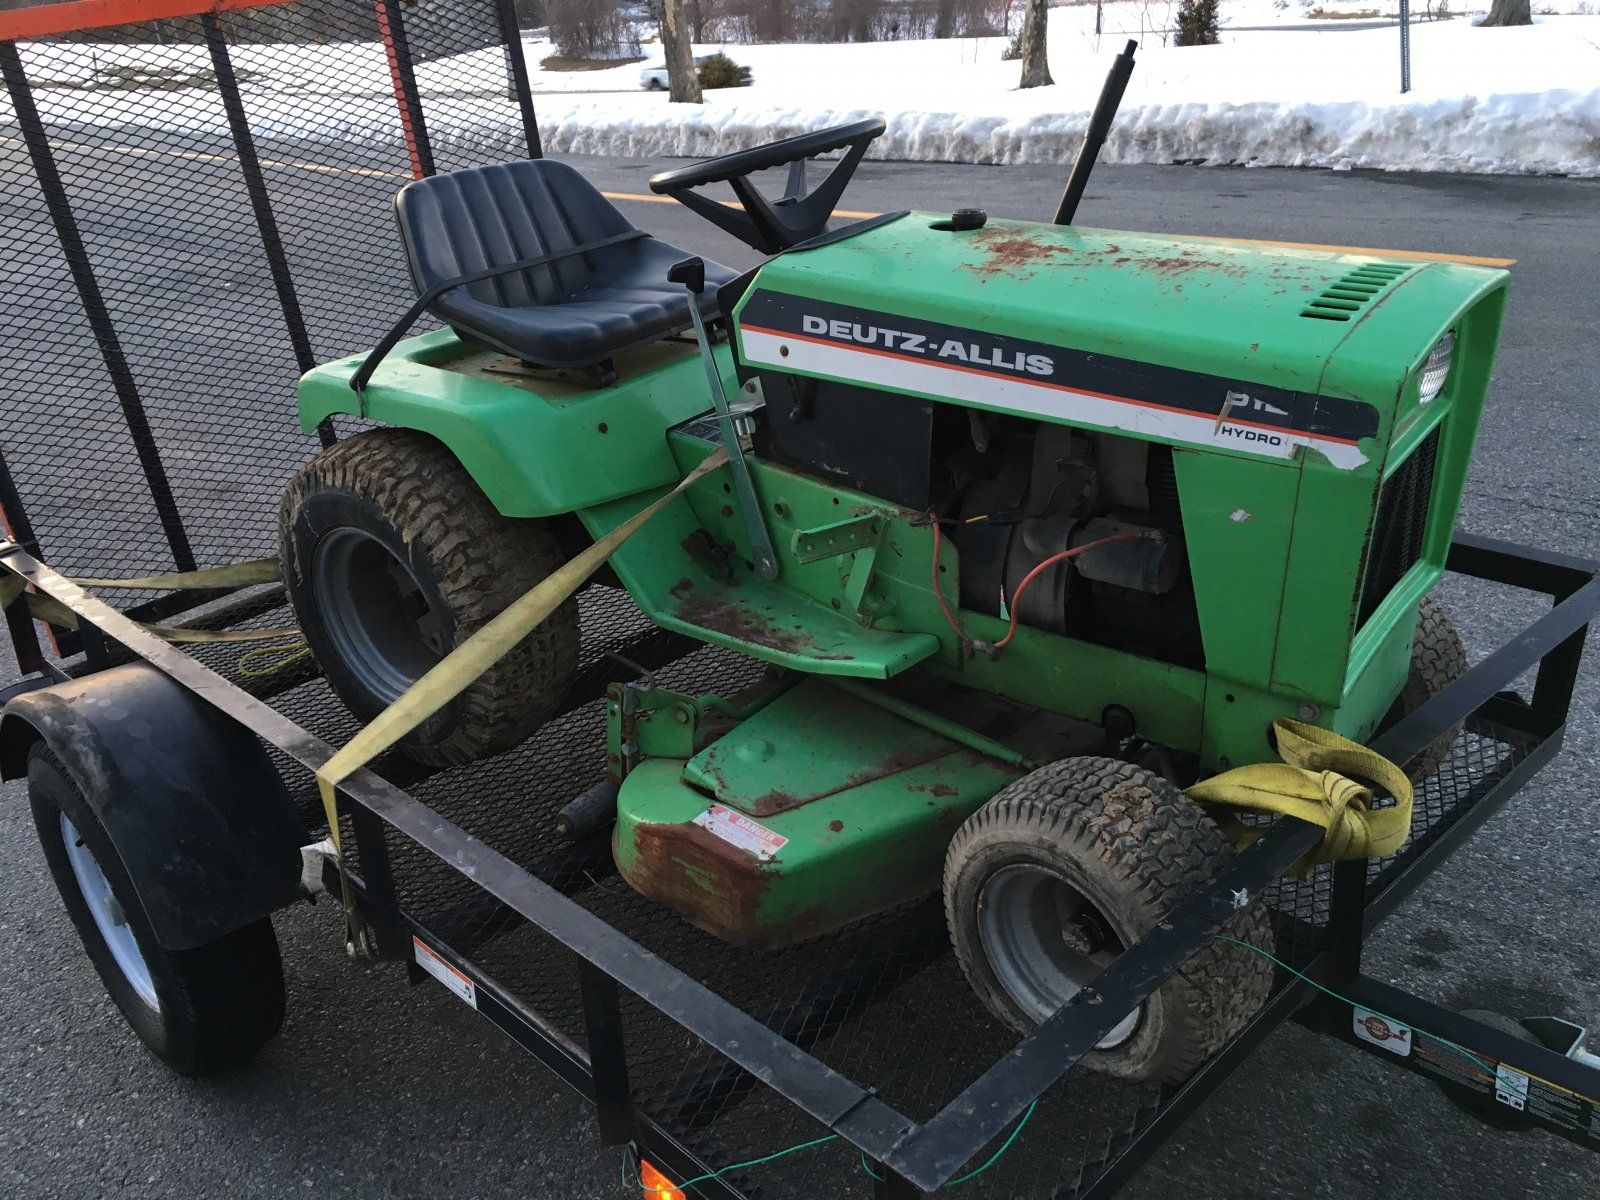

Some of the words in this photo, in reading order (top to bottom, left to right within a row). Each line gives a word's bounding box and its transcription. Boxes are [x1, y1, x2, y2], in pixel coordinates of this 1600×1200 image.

[802, 315, 1055, 376] DEUTZ-ALLIS
[1221, 426, 1282, 446] HYDRO
[735, 817, 775, 842] DANGER
